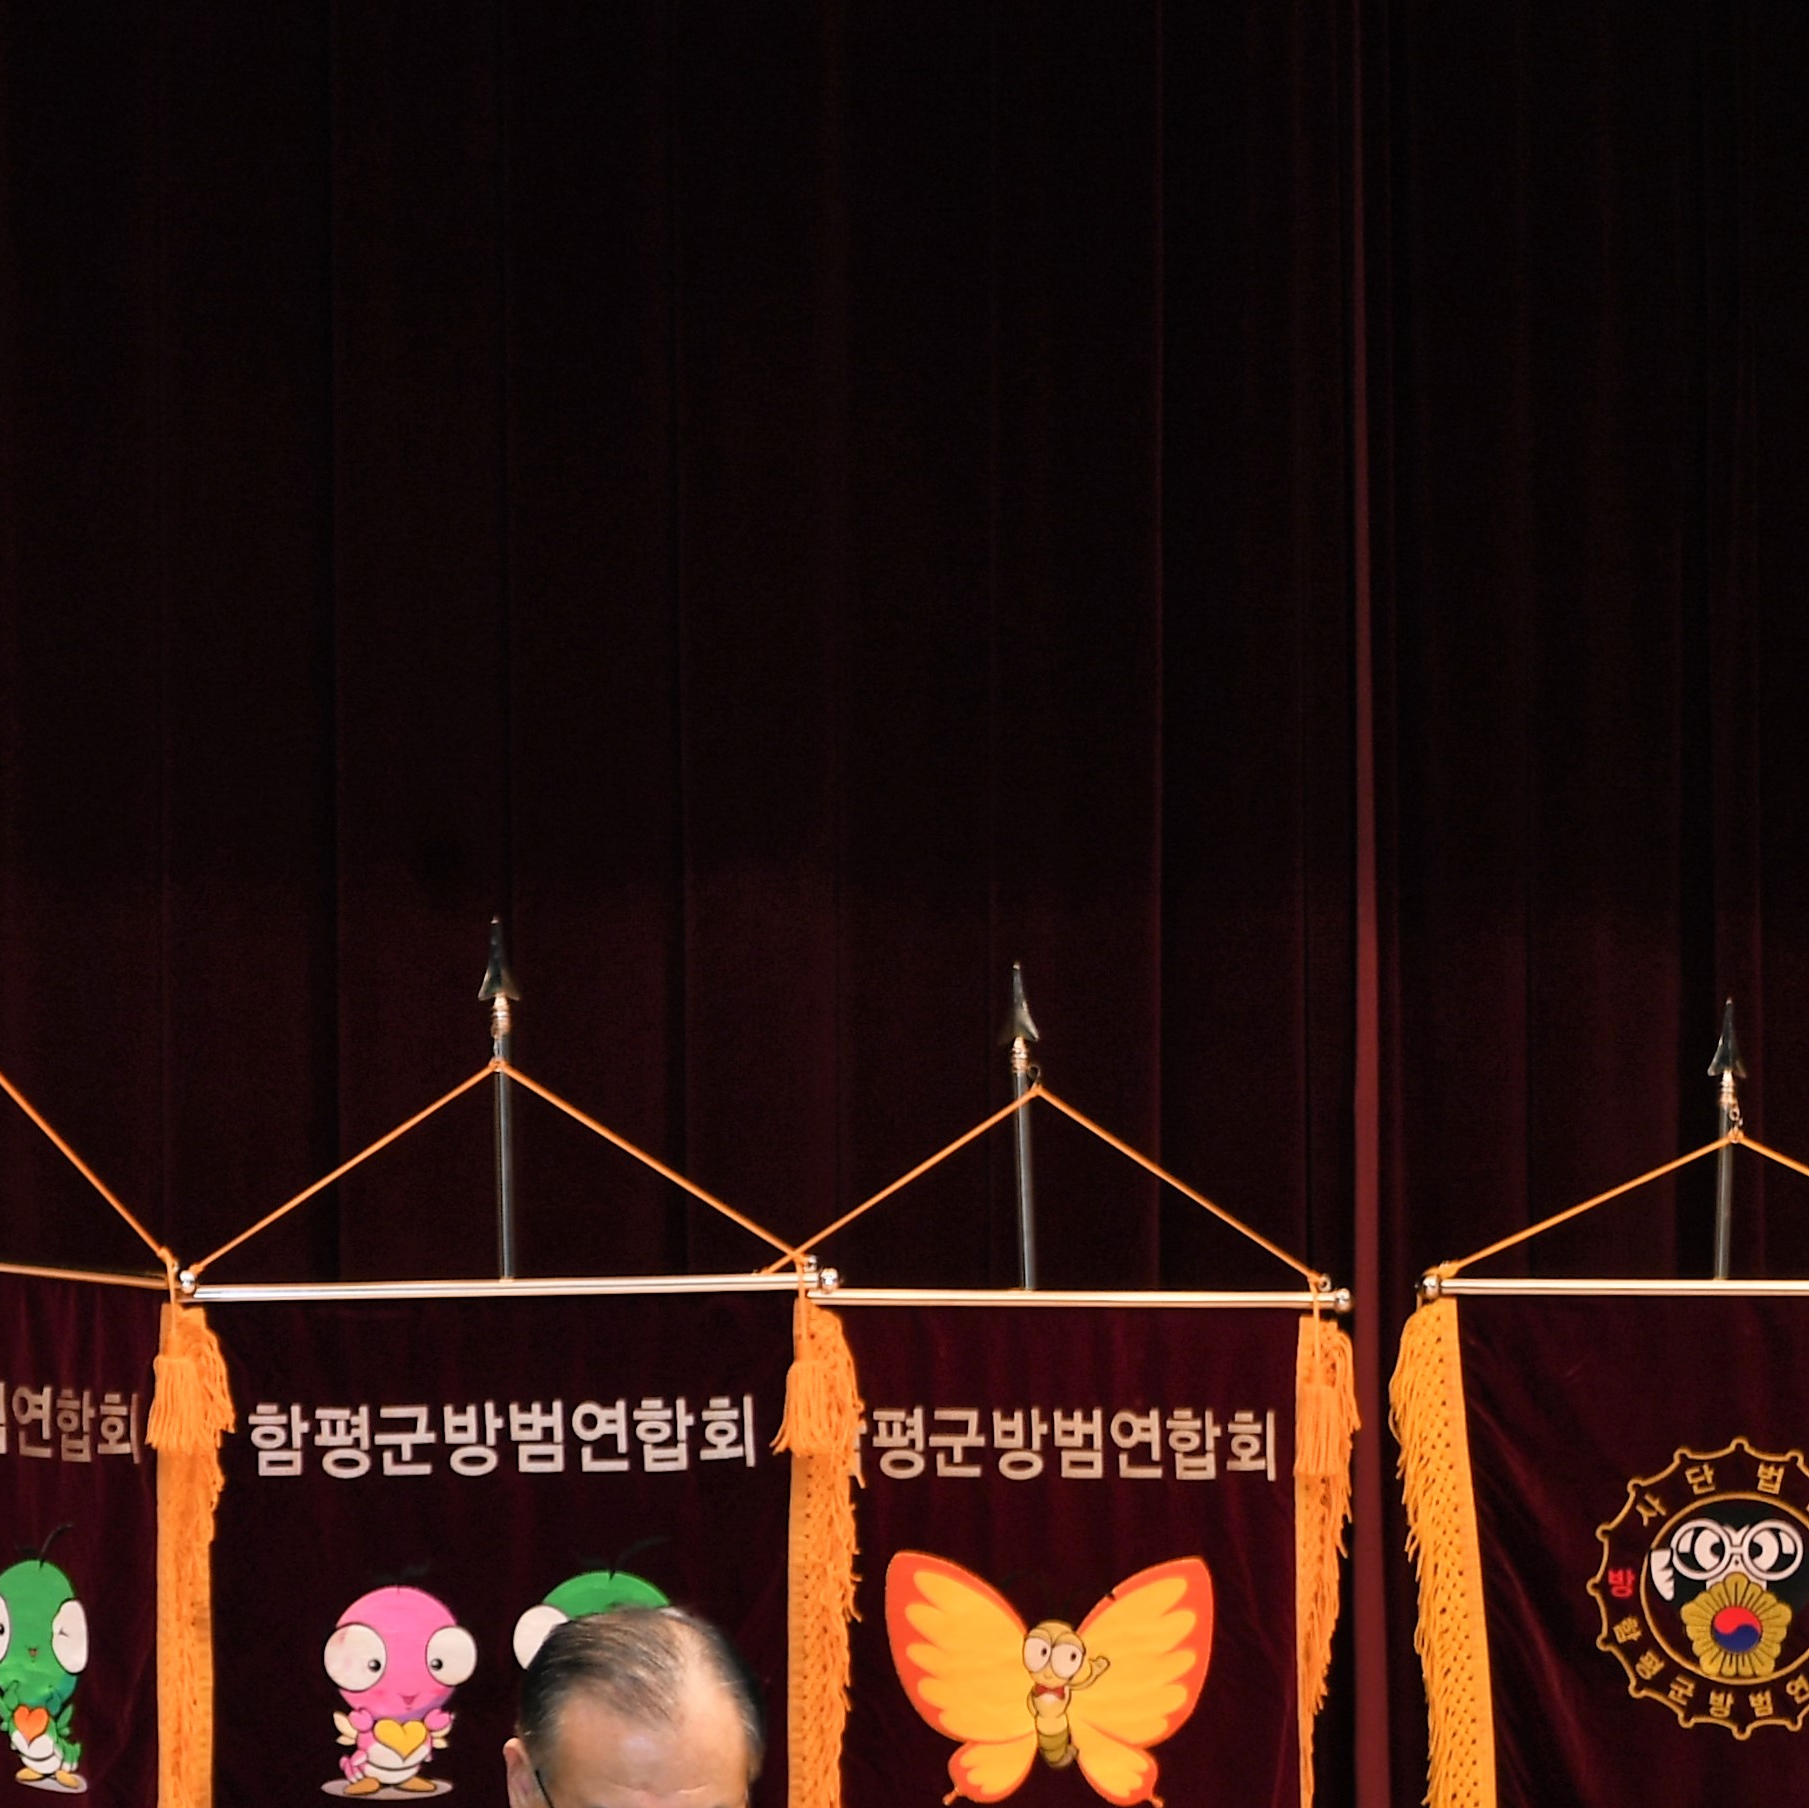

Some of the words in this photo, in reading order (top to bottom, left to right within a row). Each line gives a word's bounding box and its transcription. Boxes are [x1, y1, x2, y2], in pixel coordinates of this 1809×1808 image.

[247, 1393, 756, 1479] 함평군방범연합회
[855, 1404, 1278, 1482] 평군방범연합회
[1635, 1461, 1809, 1528] 사단법
